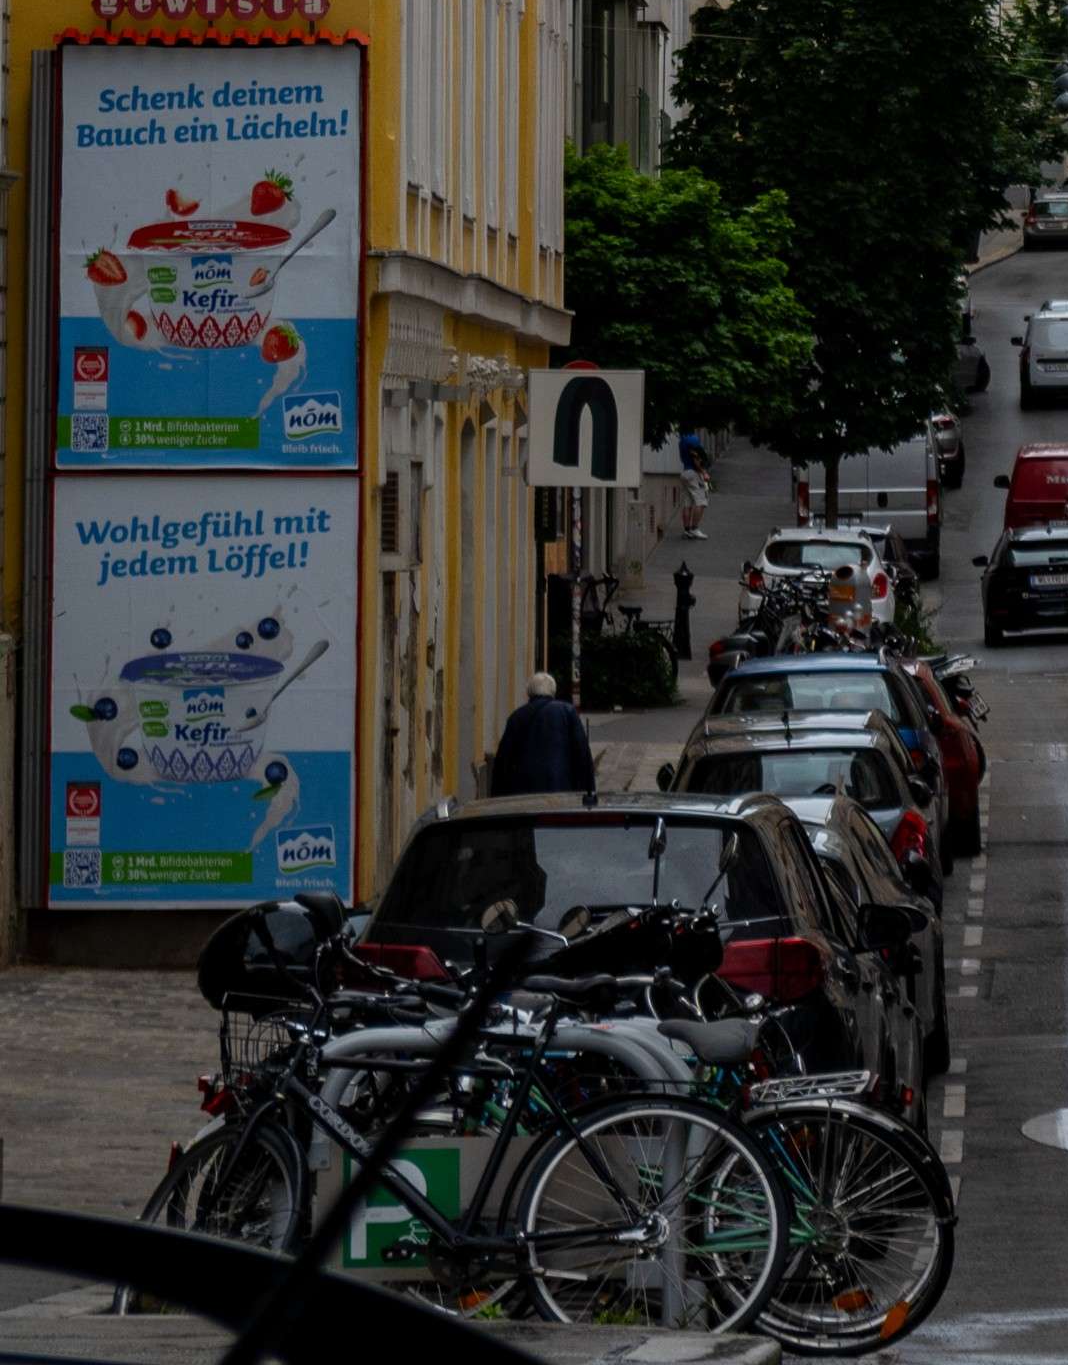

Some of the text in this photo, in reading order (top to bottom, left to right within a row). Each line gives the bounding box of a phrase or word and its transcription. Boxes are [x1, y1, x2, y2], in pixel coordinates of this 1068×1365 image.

[98, 80, 324, 112] Schenk deinem
[76, 109, 349, 147] Bauch ein Lächeln!
[182, 290, 239, 312] Kefir
[143, 422, 164, 432] Mrd.
[167, 420, 239, 432] Bifidobakterien
[135, 434, 228, 447] 30% weniger Zucker
[282, 443, 343, 454] Bleib frisch.
[76, 507, 332, 548] Wohlgefühl mit
[97, 542, 310, 584] jedem Löffel!
[175, 723, 231, 746] Kefir
[135, 857, 157, 867] Mrd.
[160, 856, 233, 868] Bifidobakterien
[149, 870, 187, 882] weniger
[189, 869, 221, 880] Zucker
[275, 877, 337, 888] Bleib frisch.
